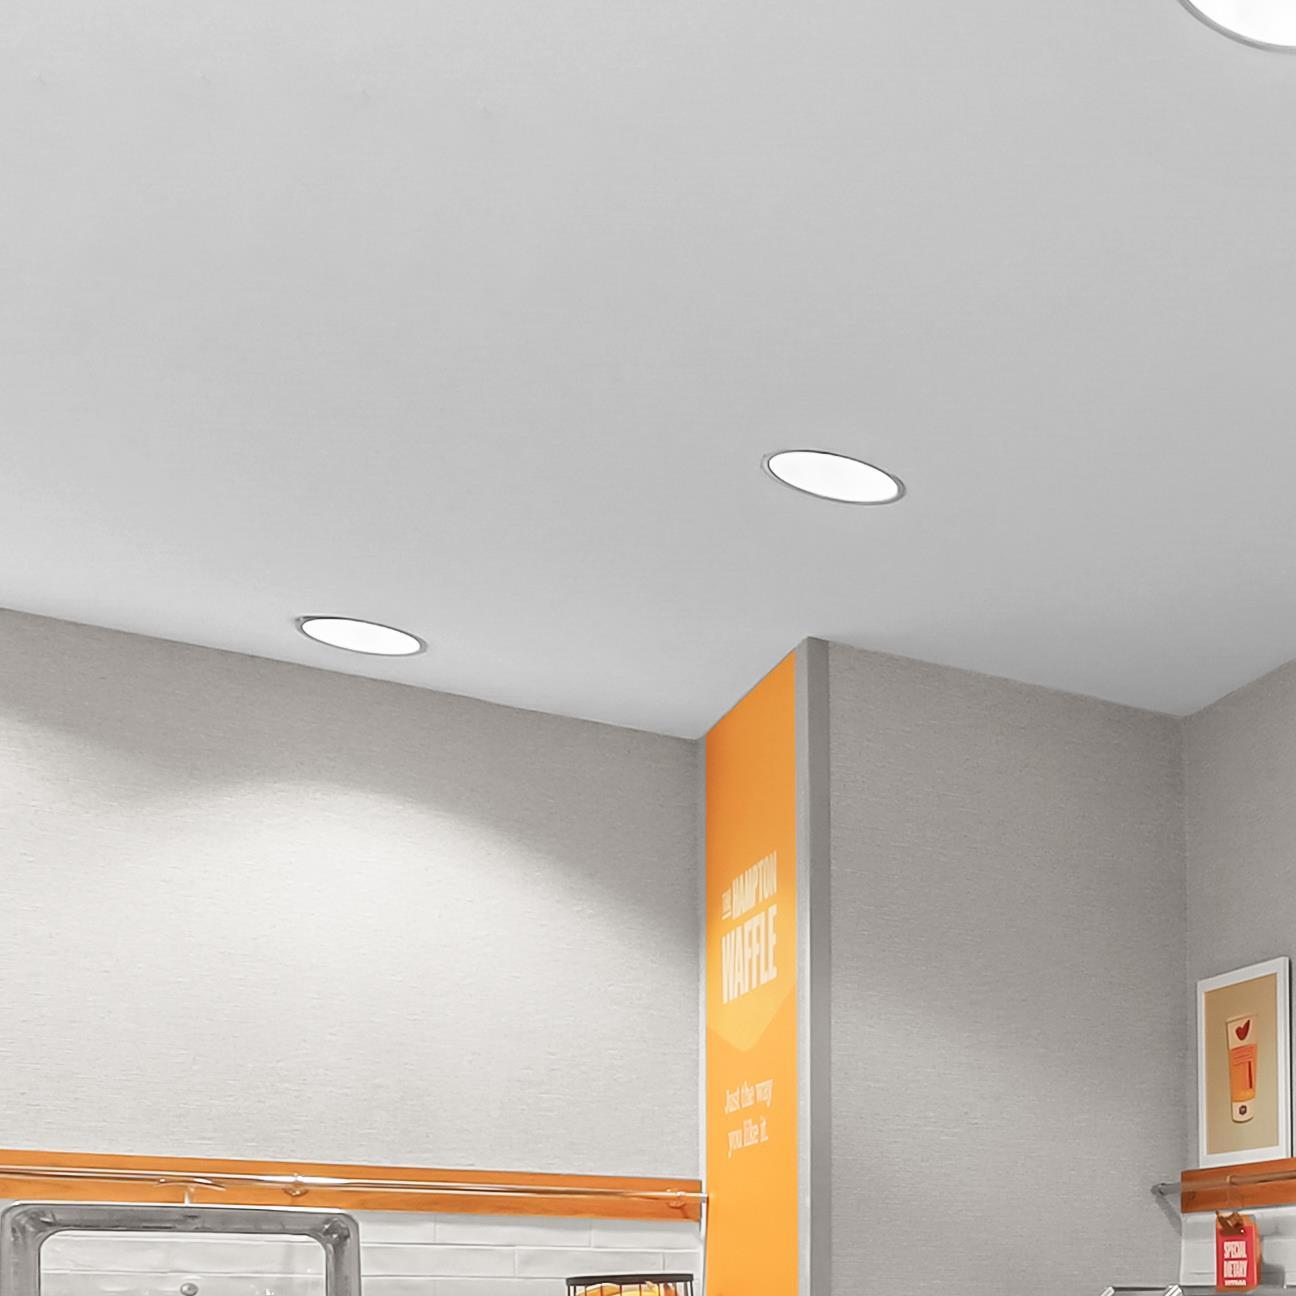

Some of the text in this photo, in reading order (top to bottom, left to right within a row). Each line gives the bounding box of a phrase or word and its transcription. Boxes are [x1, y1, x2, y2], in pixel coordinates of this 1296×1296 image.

[732, 850, 778, 921] HAMPTON
[721, 904, 778, 1005] WAFFLE
[755, 1079, 774, 1108] way
